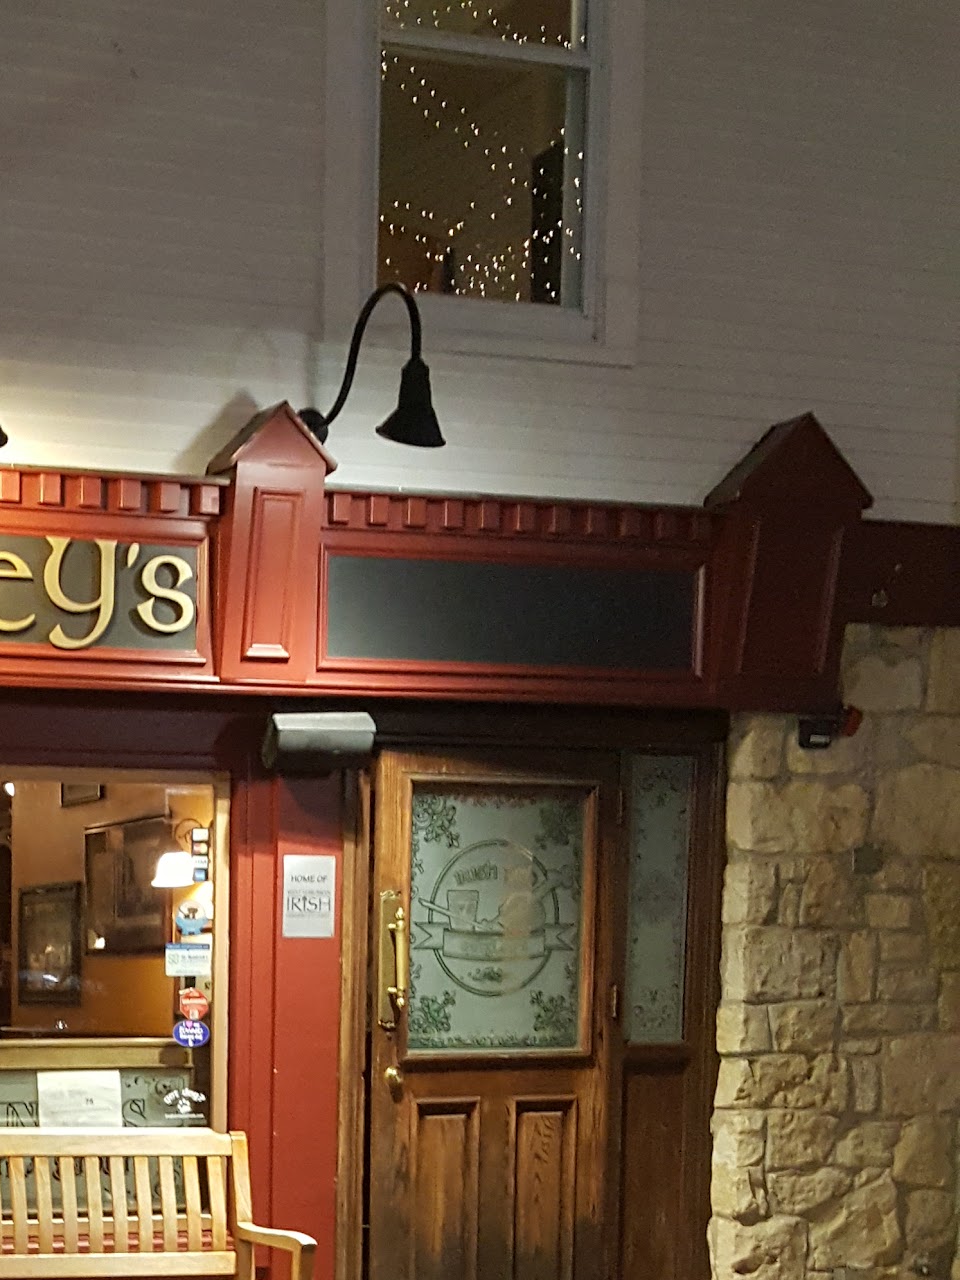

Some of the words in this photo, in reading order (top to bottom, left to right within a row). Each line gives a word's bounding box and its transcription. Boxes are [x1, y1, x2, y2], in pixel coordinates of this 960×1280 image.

[290, 874, 315, 883] HOME
[316, 874, 328, 883] OF
[286, 896, 331, 912] IRISH
